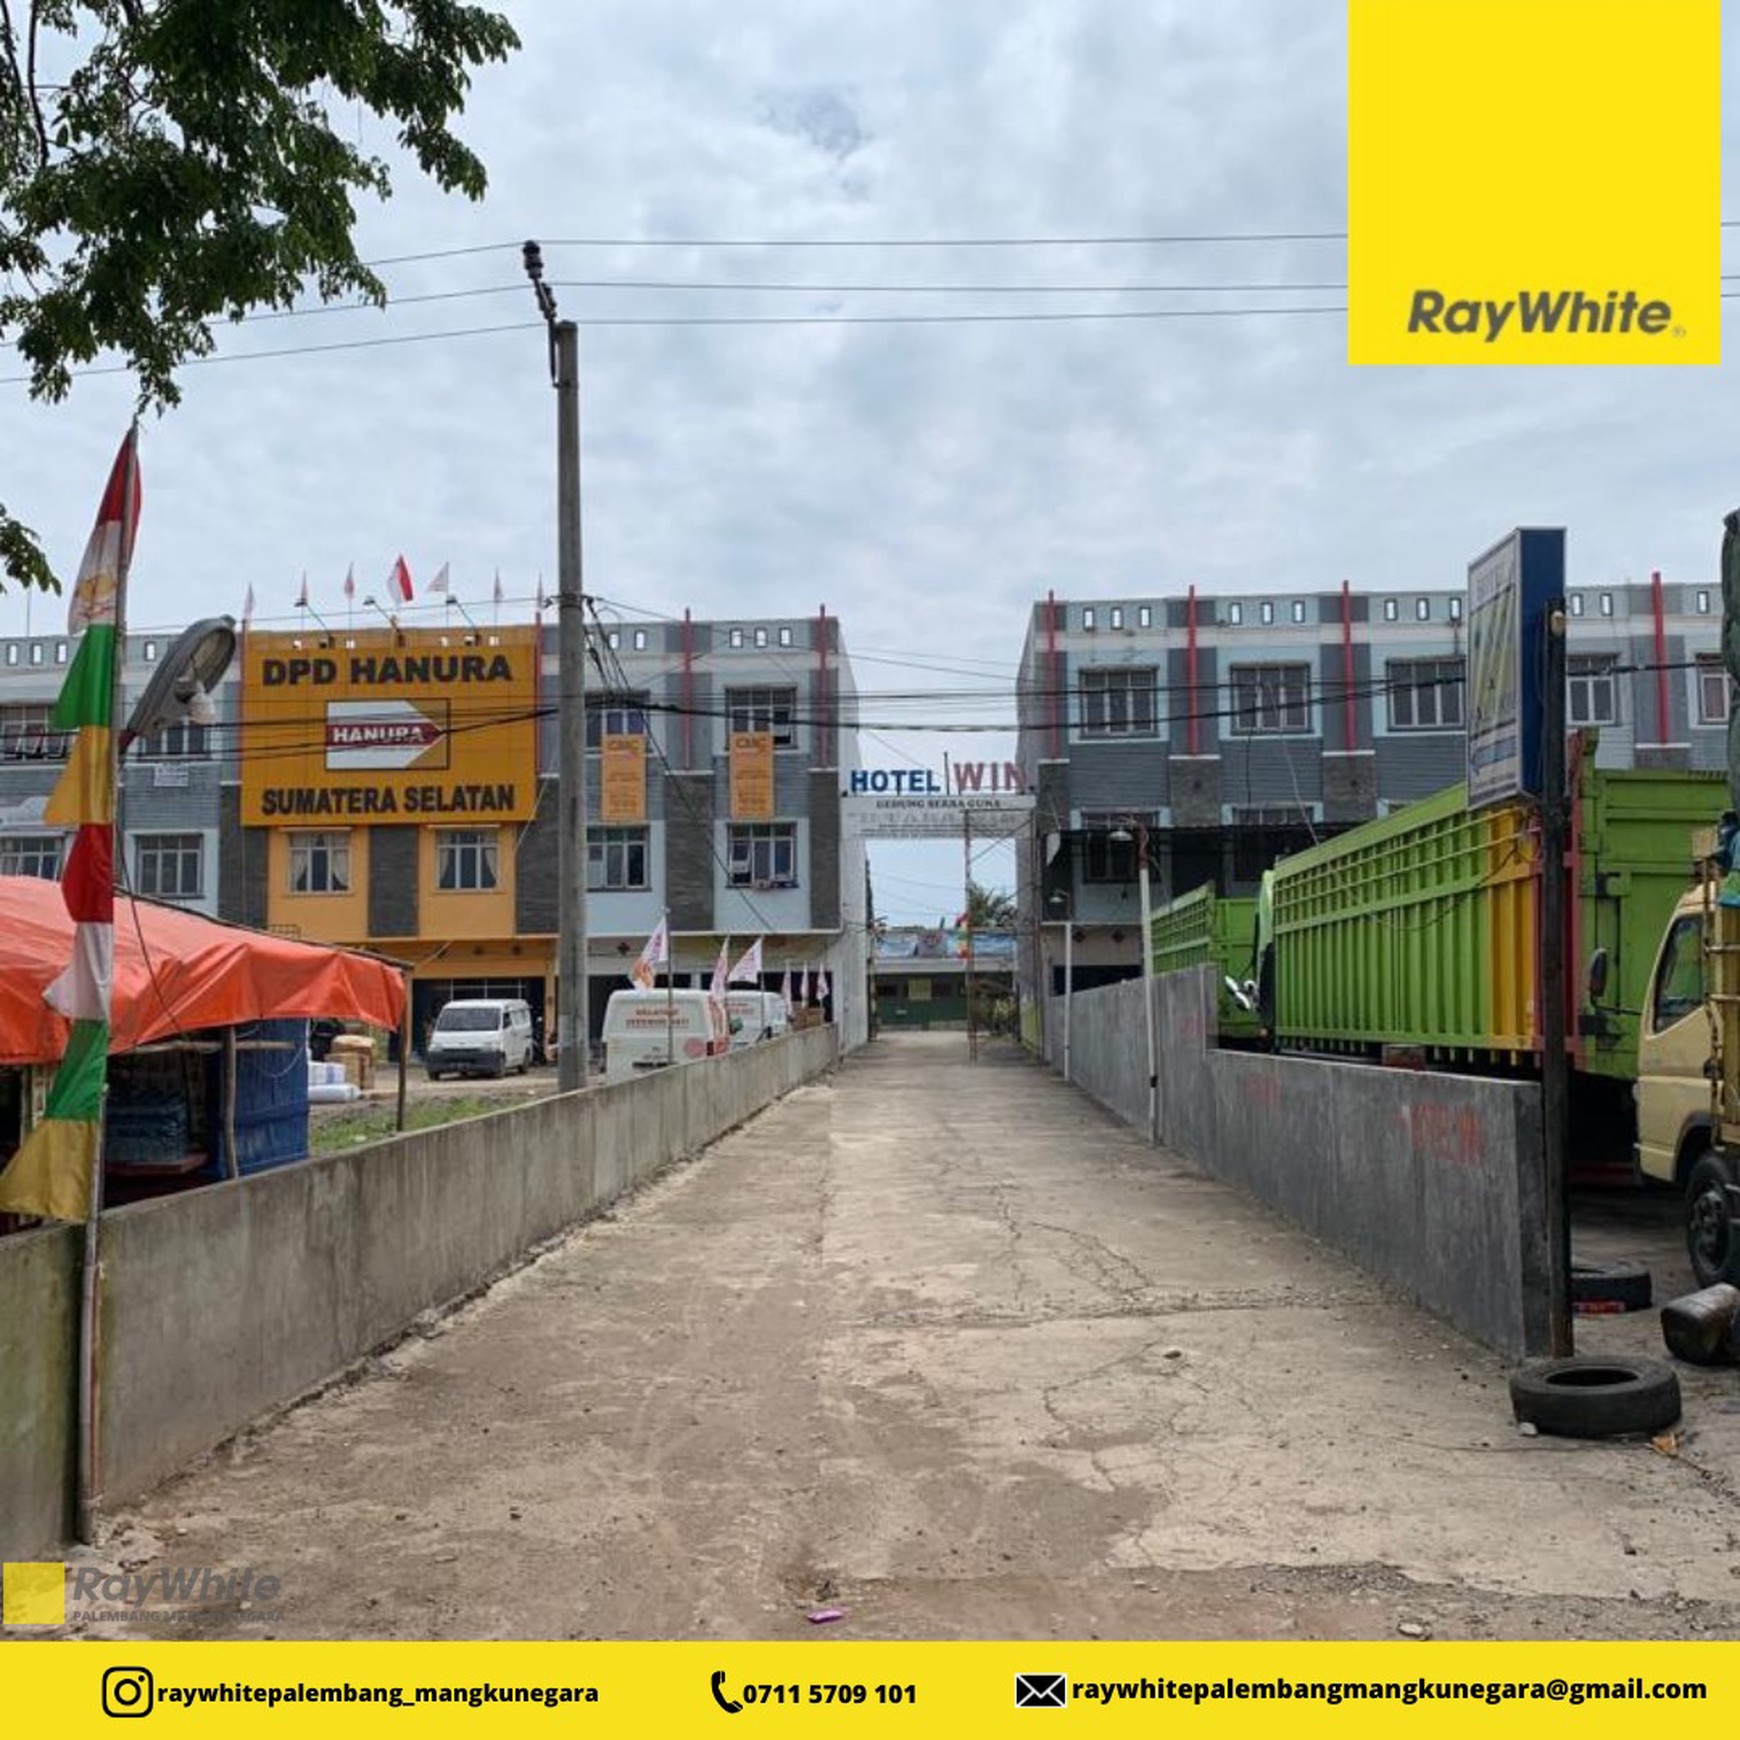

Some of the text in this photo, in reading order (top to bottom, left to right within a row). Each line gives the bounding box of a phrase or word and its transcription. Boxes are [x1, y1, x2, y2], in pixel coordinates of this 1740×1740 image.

[263, 655, 513, 686] DPD HANURA
[333, 726, 424, 743] HANURA
[850, 762, 1027, 792] HOTEL WIN
[261, 784, 515, 816] SUMATERA SELATAN
